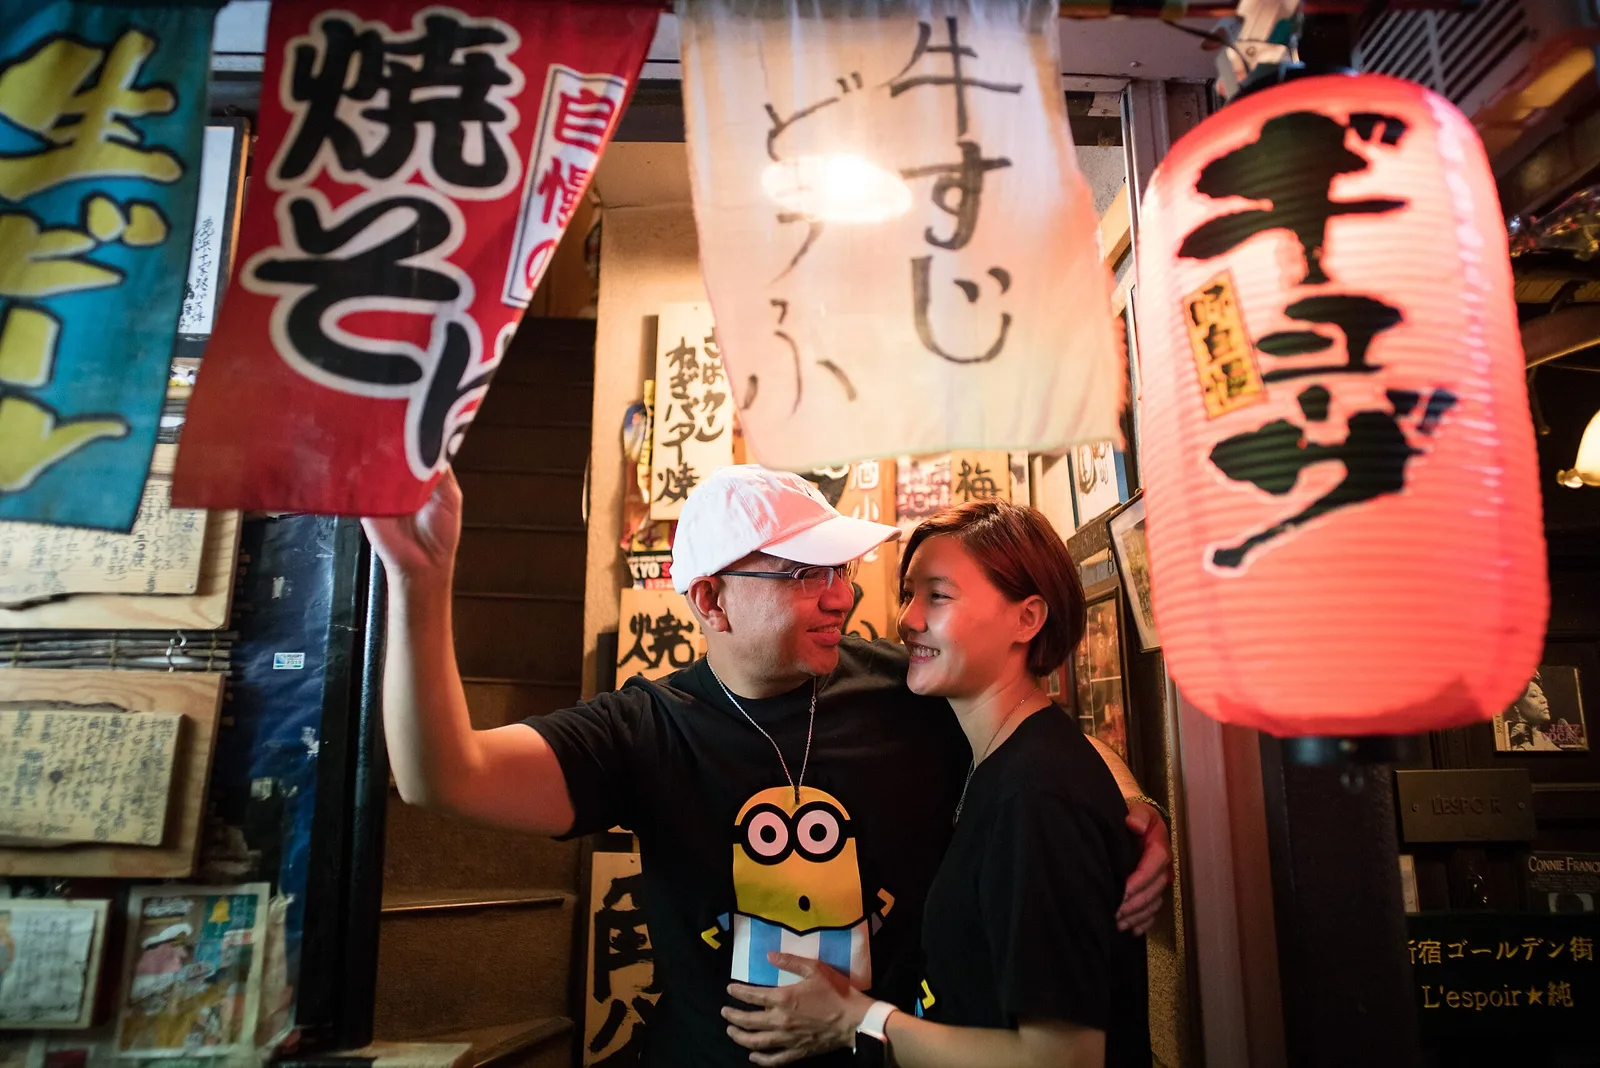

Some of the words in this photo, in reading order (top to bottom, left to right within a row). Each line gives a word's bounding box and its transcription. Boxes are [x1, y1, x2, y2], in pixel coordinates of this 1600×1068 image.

[879, 15, 1023, 364] 牛すじ
[955, 459, 1003, 502] 梅
